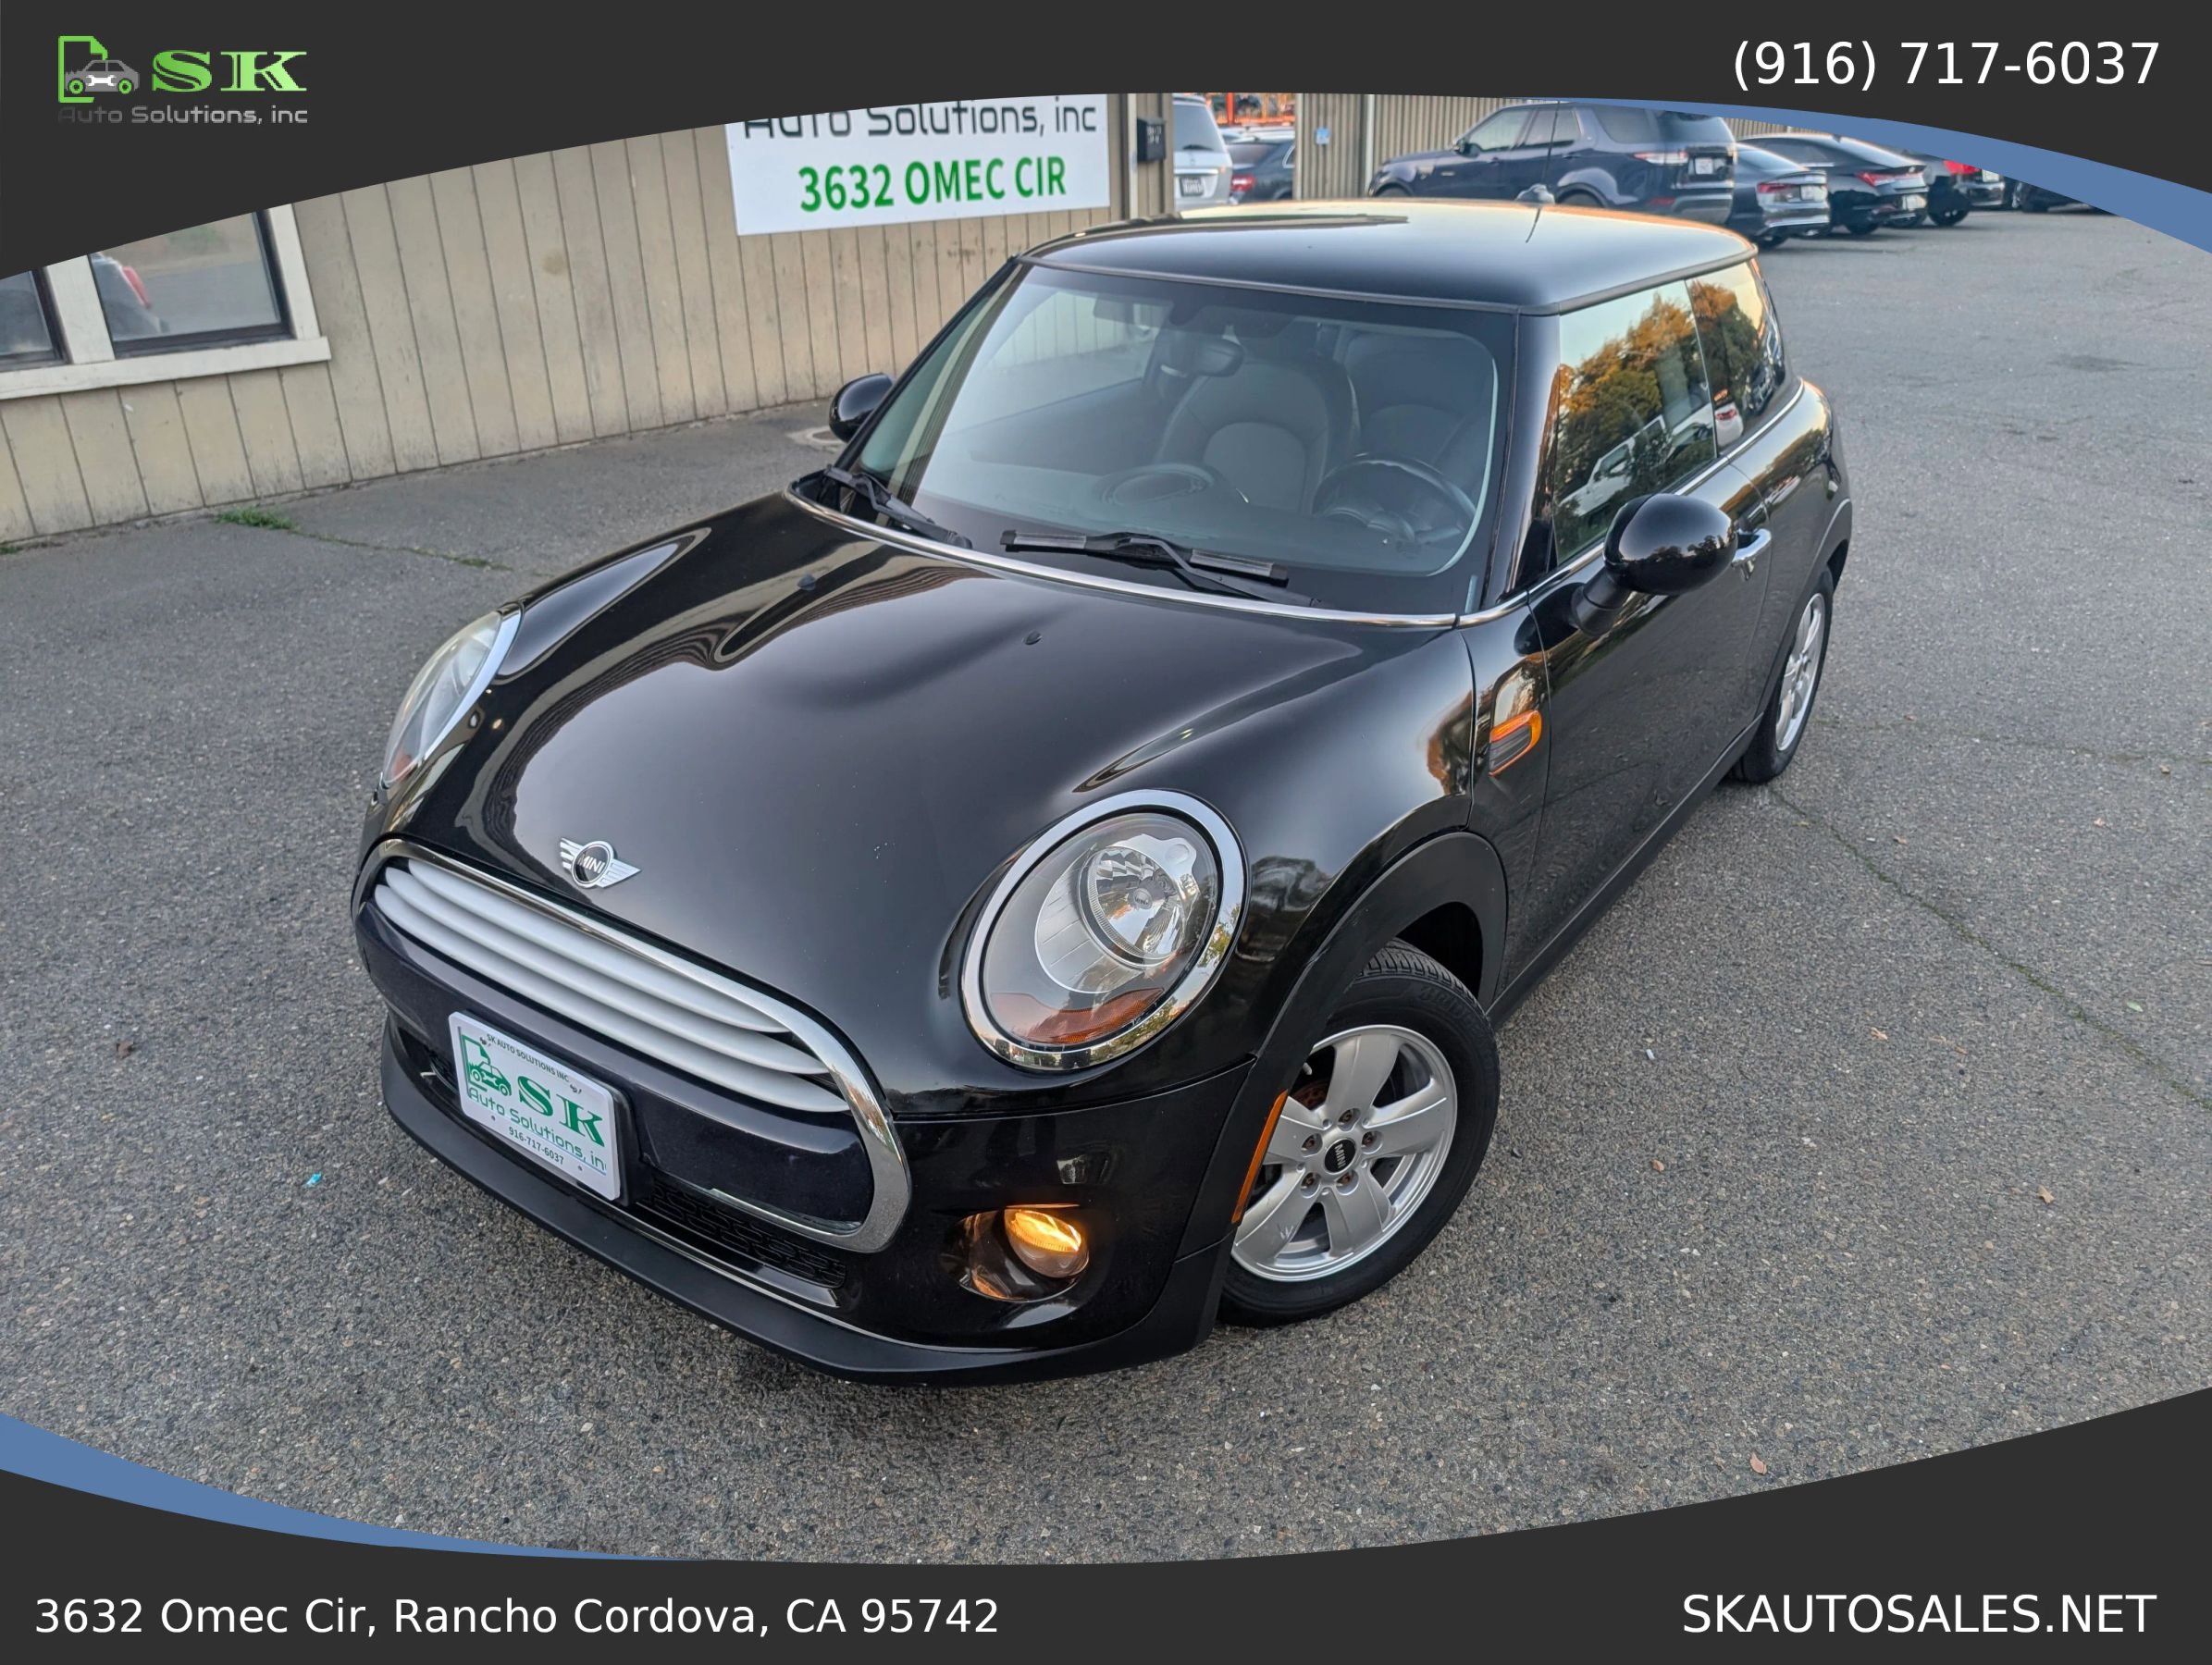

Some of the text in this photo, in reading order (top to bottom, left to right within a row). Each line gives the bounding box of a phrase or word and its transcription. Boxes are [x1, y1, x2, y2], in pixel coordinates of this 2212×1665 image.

[867, 99, 1045, 138] Solutions,
[1055, 96, 1097, 132] inc
[798, 156, 1067, 212] 3632 OMEC CIR
[577, 853, 606, 874] MINI
[497, 1040, 515, 1054] AUTO
[515, 1049, 556, 1075] SOLUTIONS
[556, 1071, 570, 1082] INC
[468, 1087, 607, 1171] Auto Solutions, in
[518, 1076, 605, 1147] SK
[508, 1126, 564, 1166] 916-717-6037
